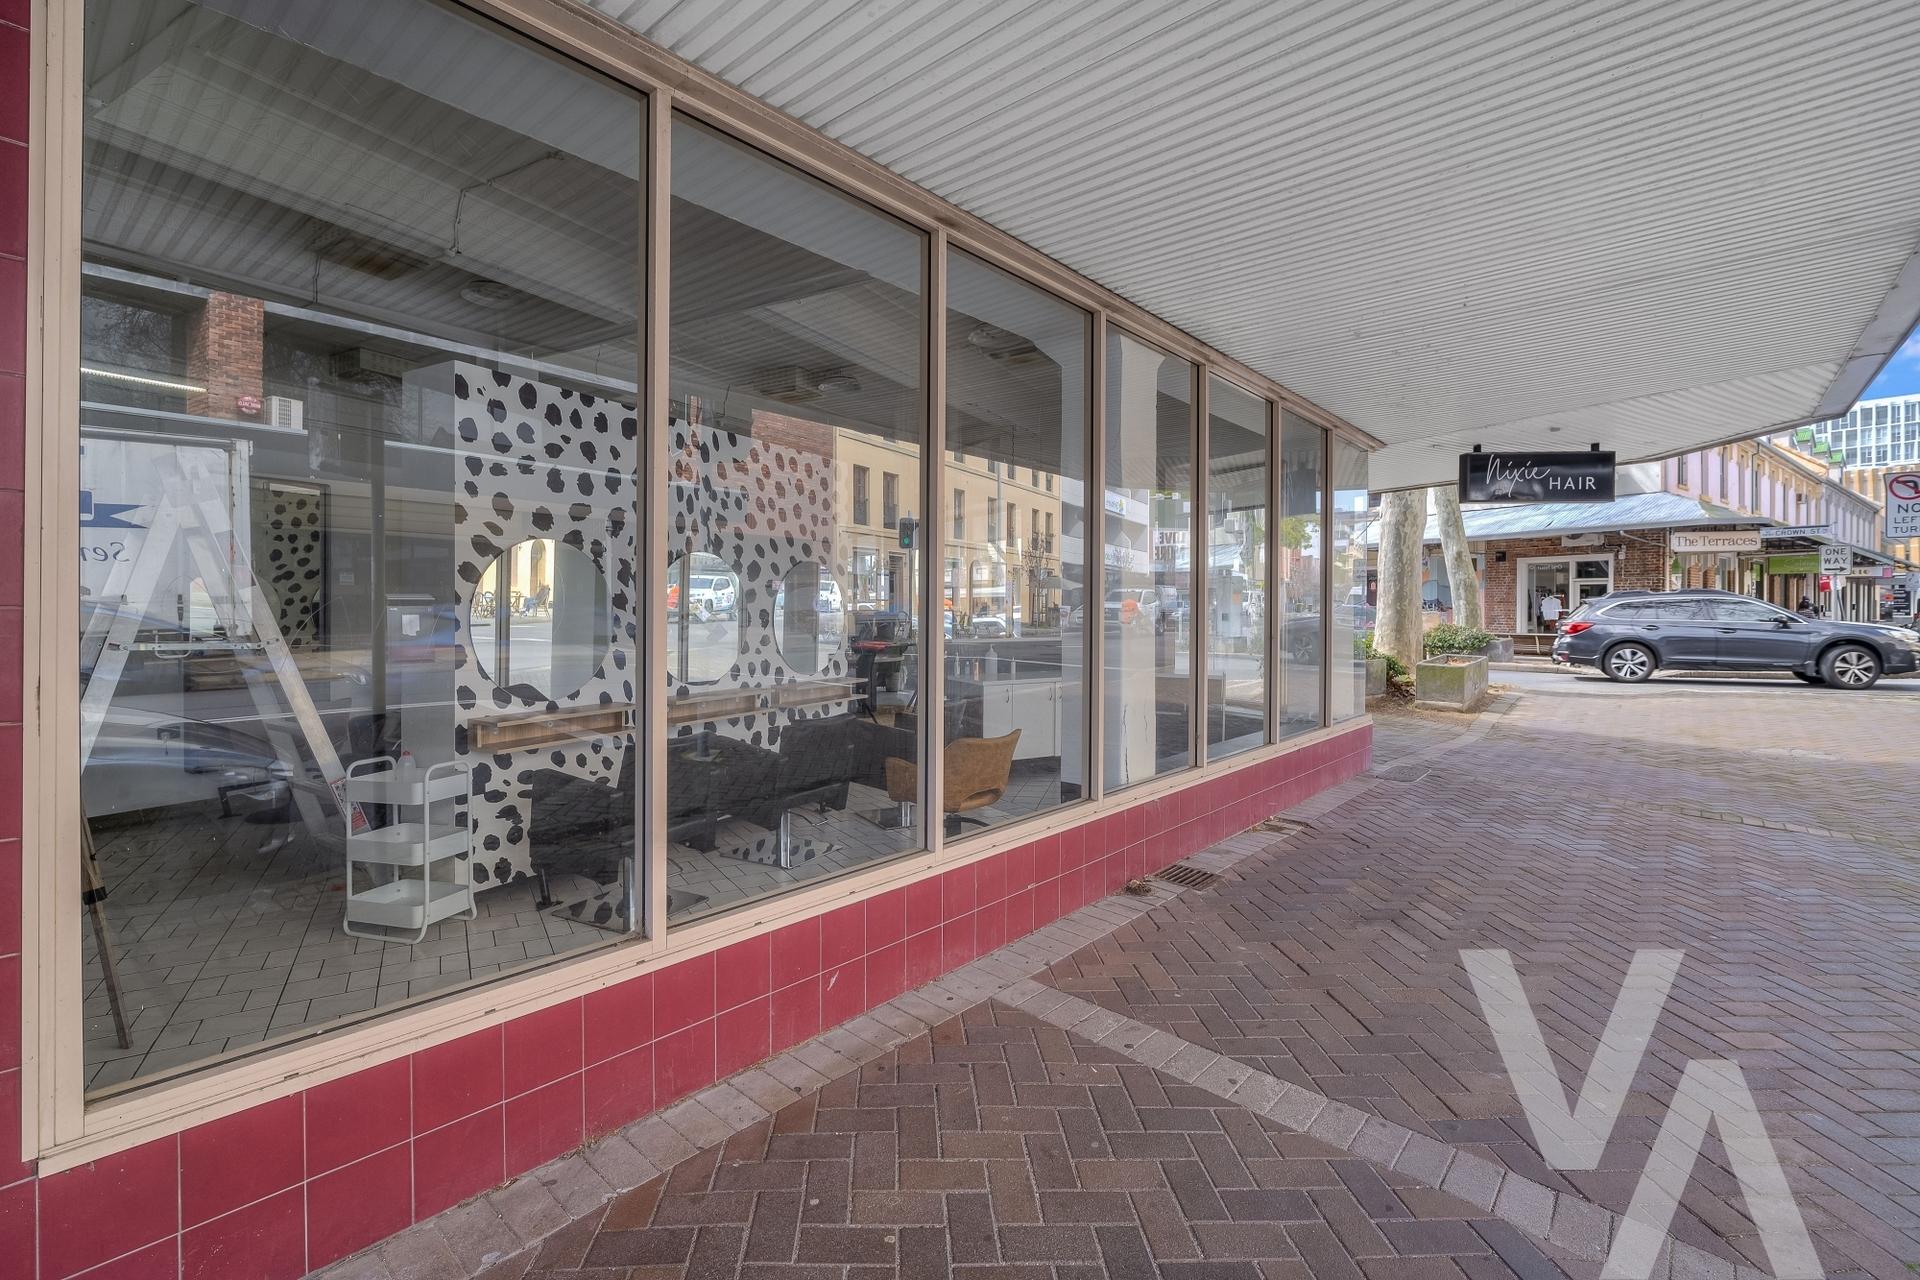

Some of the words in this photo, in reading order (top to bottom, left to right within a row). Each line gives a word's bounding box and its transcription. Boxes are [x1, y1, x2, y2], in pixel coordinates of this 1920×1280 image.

[1486, 454, 1551, 498] Nixie
[1549, 476, 1597, 490] HAIR
[1897, 502, 1920, 514] NO
[1775, 529, 1806, 537] CROWN
[1893, 525, 1920, 534] TUR
[1675, 536, 1698, 547] The
[1699, 535, 1758, 546] Terraces
[1825, 547, 1847, 556] ONE
[1823, 557, 1848, 565] WAY
